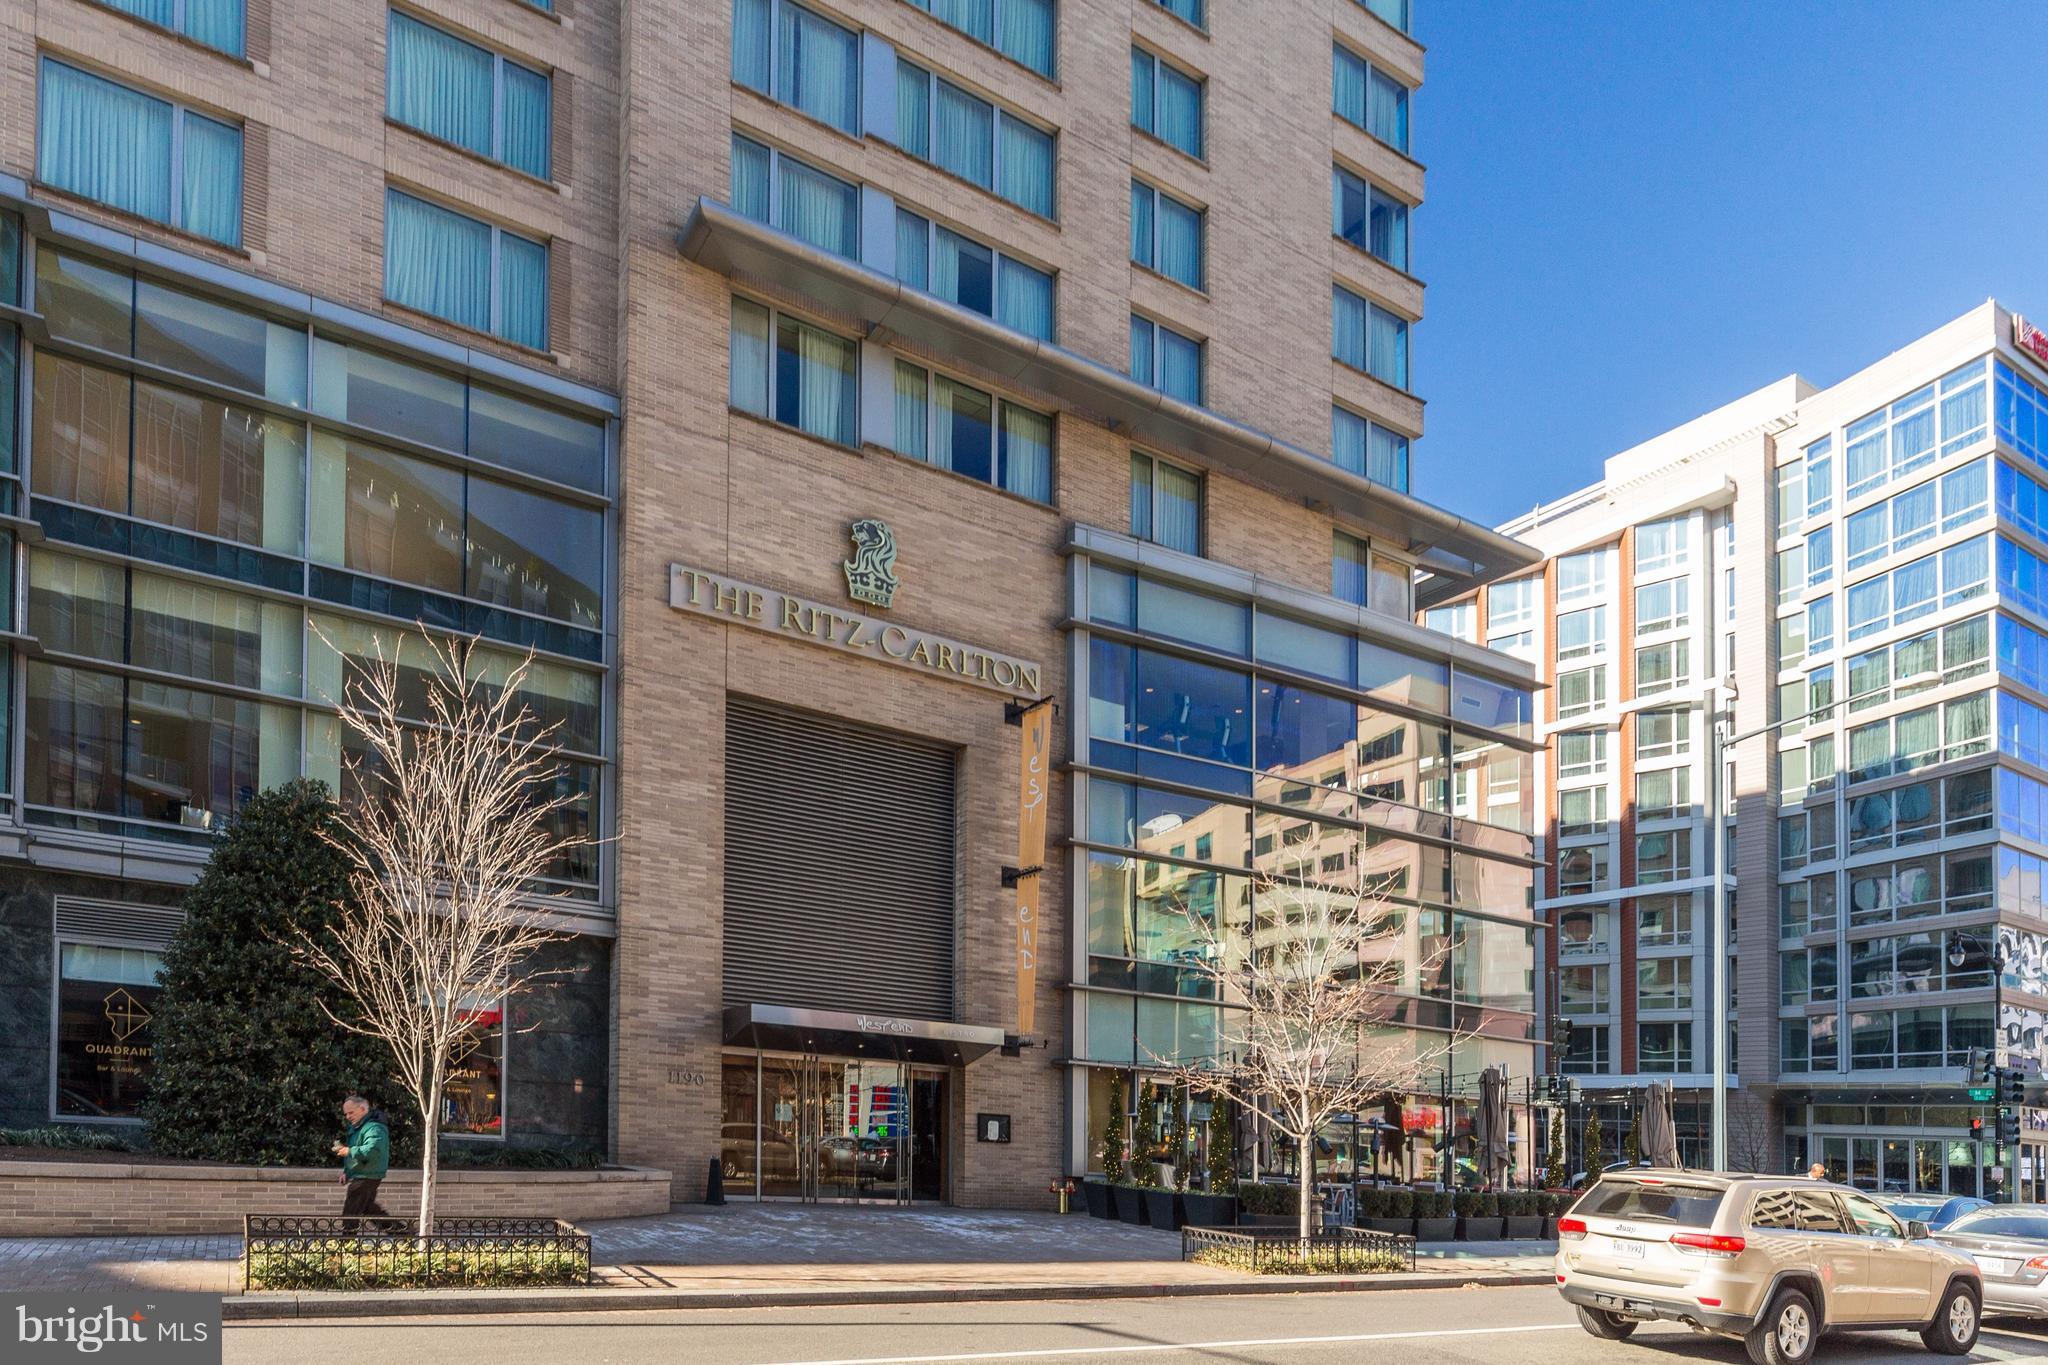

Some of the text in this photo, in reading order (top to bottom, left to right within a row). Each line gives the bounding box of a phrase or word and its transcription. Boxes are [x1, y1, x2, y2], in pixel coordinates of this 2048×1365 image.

[679, 568, 1040, 696] THE RITZ-CARLTON
[84, 1043, 152, 1057] QUADRANT
[668, 1071, 705, 1087] 1190
